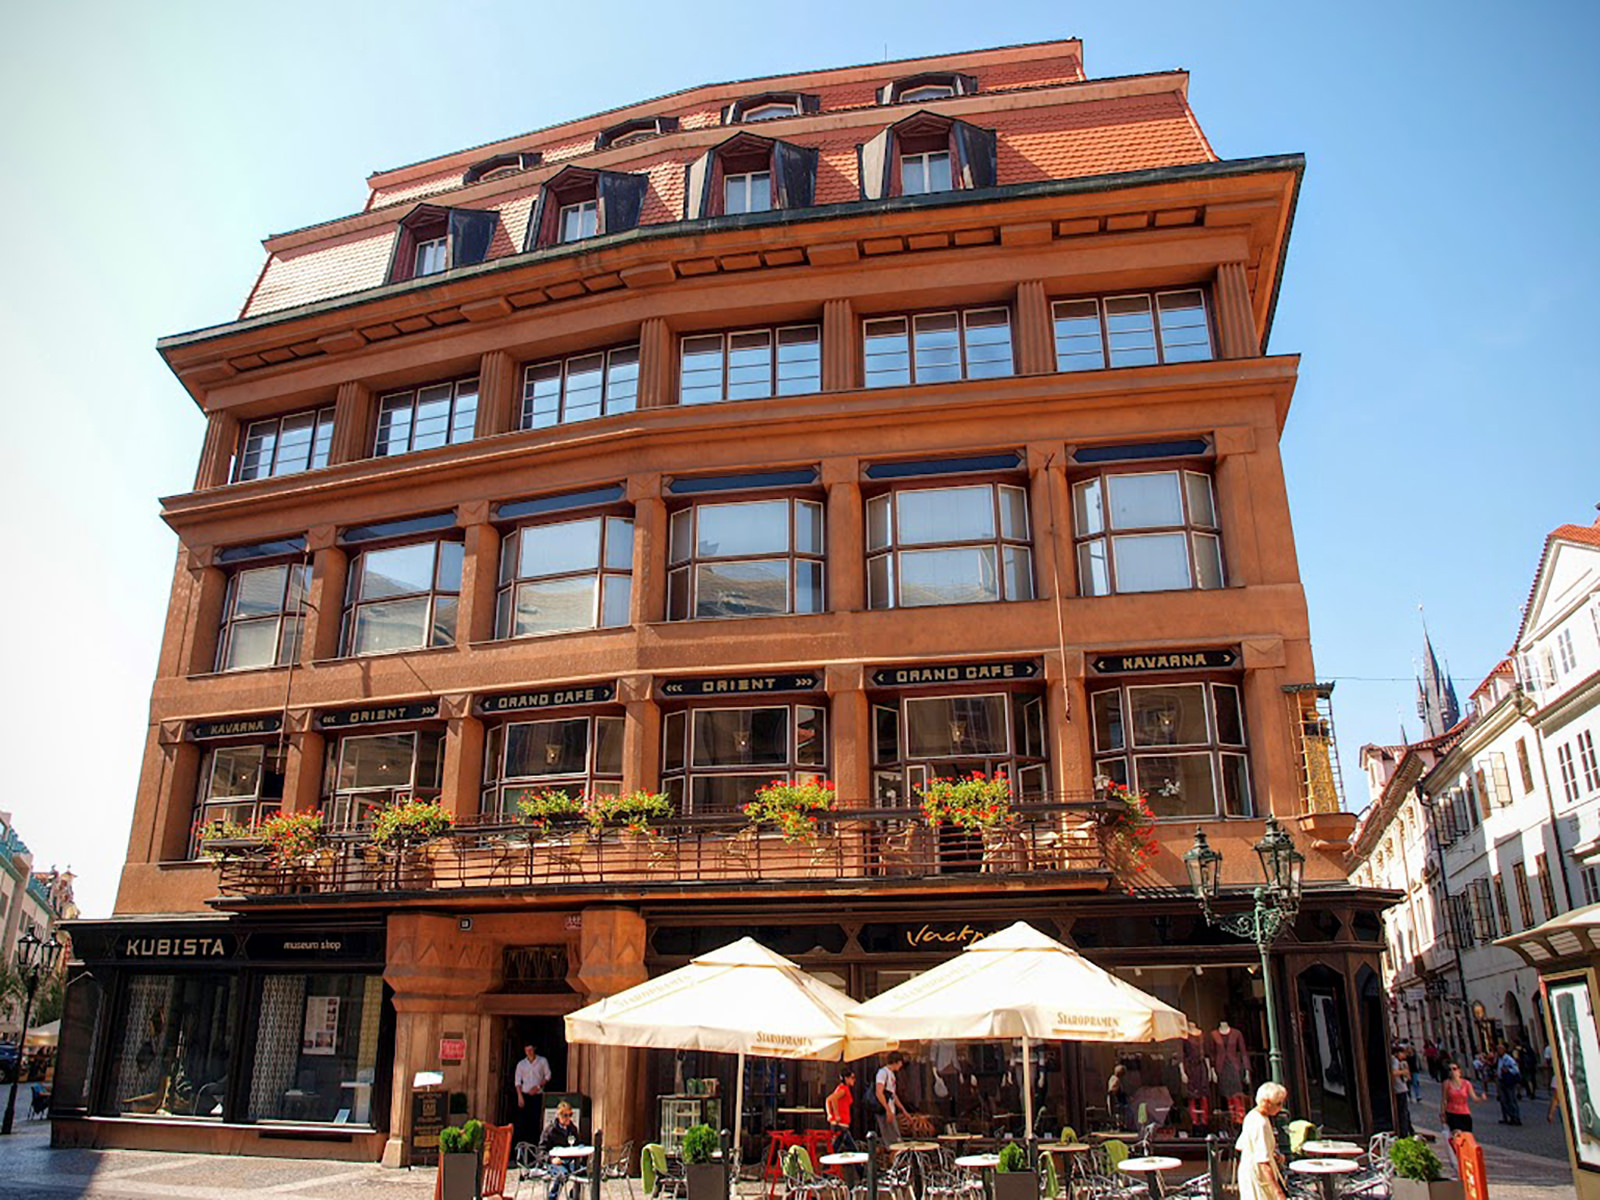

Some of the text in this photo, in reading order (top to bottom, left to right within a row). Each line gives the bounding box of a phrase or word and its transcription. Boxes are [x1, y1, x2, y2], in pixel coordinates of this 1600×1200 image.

[1122, 654, 1207, 669] KAVARNA
[896, 665, 1014, 682] GRAND CAFE
[702, 679, 776, 692] ORIENT
[498, 690, 595, 708] GRAND CAFE
[350, 708, 406, 722] ORIENT
[210, 721, 264, 735] KAVARNA
[126, 939, 225, 956] KUBISTA
[320, 939, 342, 952] shop
[1057, 1012, 1119, 1027] STAROPRAMEN
[756, 1031, 813, 1046] STAROPRAMEN
